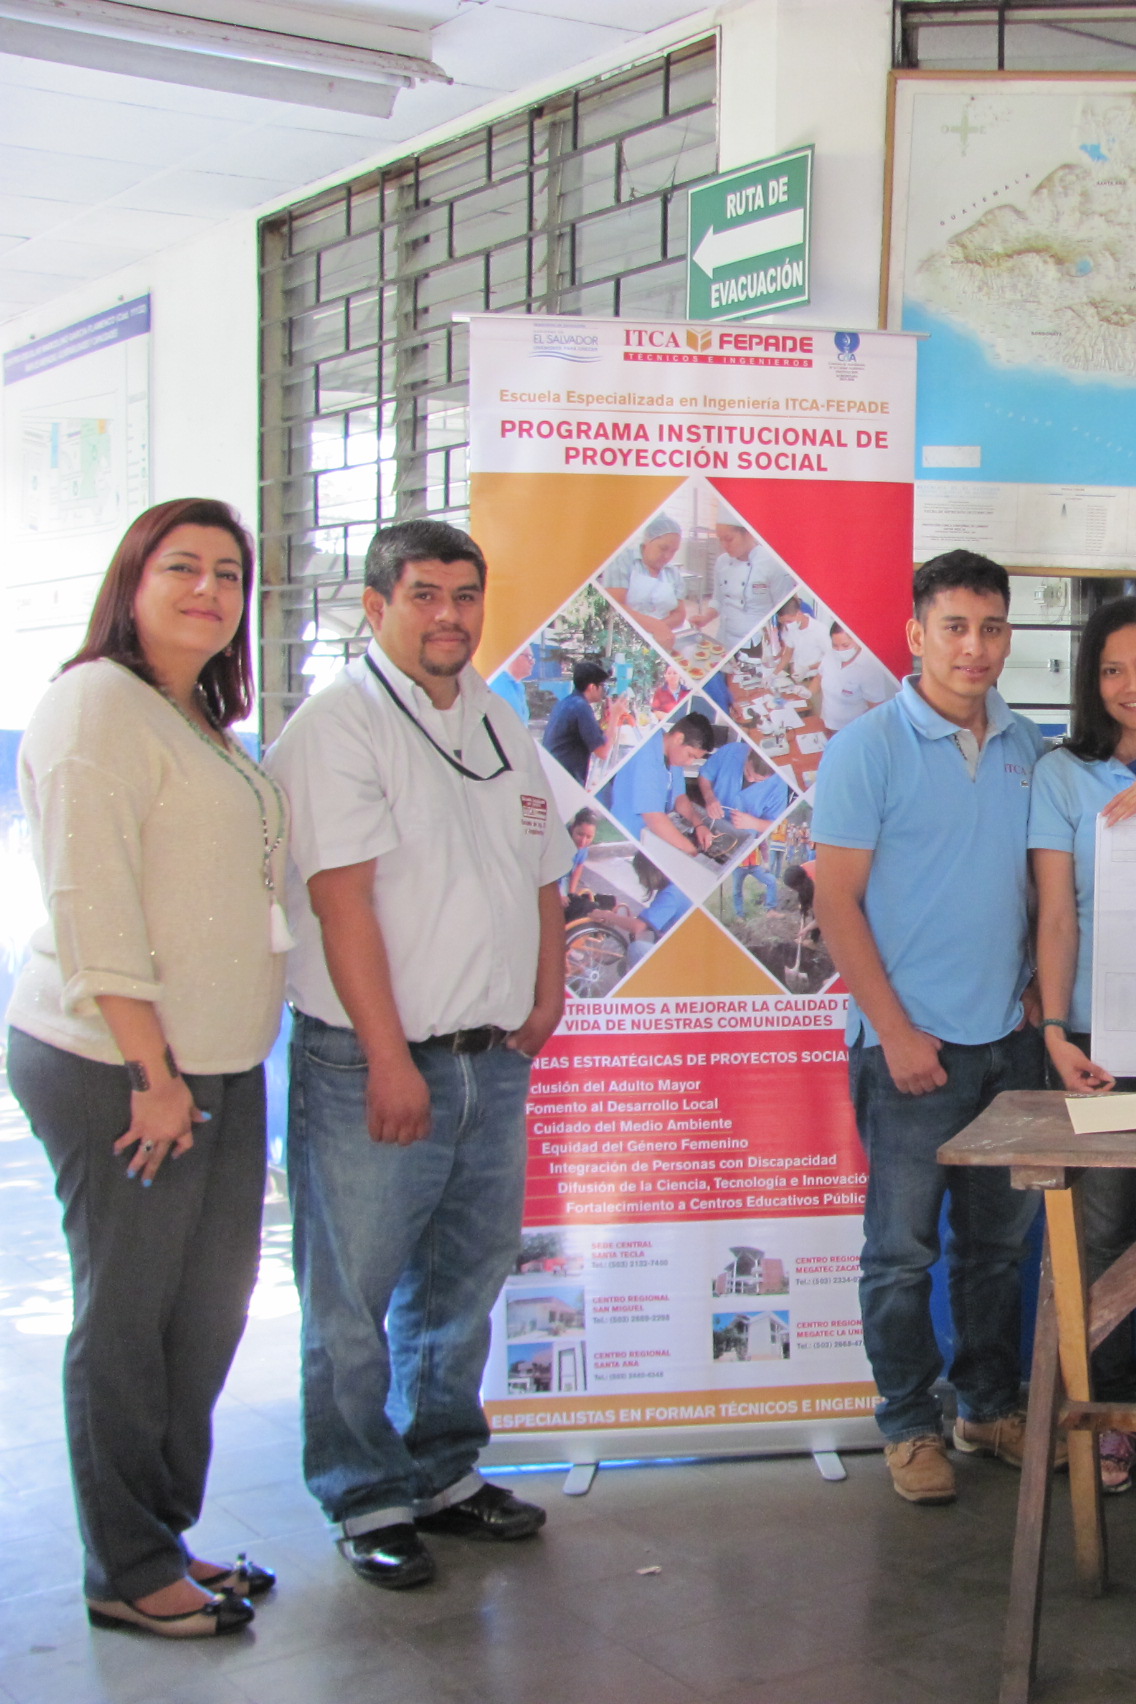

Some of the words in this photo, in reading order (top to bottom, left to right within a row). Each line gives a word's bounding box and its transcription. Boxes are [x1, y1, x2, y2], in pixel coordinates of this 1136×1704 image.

[726, 184, 764, 219] RUTA
[768, 176, 788, 206] DE
[711, 258, 803, 308] EVACUACIÓN
[533, 335, 544, 344] EL
[546, 335, 599, 346] SALVADOR
[624, 329, 681, 348] ITCA
[719, 333, 813, 353] FEPADE
[629, 353, 698, 363] TÉCNICOS
[724, 357, 809, 367] INGENIEROS
[500, 389, 561, 403] Escuela
[566, 390, 674, 407] Especializada
[680, 397, 698, 407] en
[703, 395, 780, 411] Ingeniería
[785, 398, 890, 414] ITCA-FEPADE
[501, 420, 650, 442] PROGRAMA
[659, 424, 848, 448] INSTITUCIONAL
[857, 430, 888, 449] DE
[565, 446, 728, 469] PROYECCIÓN
[737, 451, 828, 472] SOCIAL
[563, 1002, 655, 1016] TRIBUIMOS
[660, 1003, 671, 1014] A
[675, 1001, 747, 1014] MEJORAR
[752, 1000, 769, 1012] LA
[774, 999, 838, 1012] CALIDAD
[565, 1019, 601, 1032] VIDA
[606, 1019, 626, 1031] DE
[631, 1017, 713, 1030] NUESTRAS
[717, 1015, 833, 1029] COMUNIDADES
[531, 1056, 569, 1070] NEAS
[573, 1053, 683, 1068] ESTRATÉGICAS
[687, 1054, 707, 1066] DE
[710, 1051, 797, 1065] PROYECTOS
[530, 1082, 579, 1094] clusión
[583, 1080, 604, 1092] del
[608, 1080, 654, 1092] Adulto
[658, 1079, 701, 1093] Mayor
[525, 1102, 587, 1115] Fomento
[591, 1101, 603, 1113] al
[607, 1099, 679, 1112] Desarrollo
[683, 1098, 719, 1110] Local
[533, 1121, 591, 1134] Cuidado
[595, 1120, 615, 1132] del
[620, 1119, 663, 1132] Medio
[667, 1118, 733, 1131] Ambiente
[542, 1141, 598, 1156] Equidad
[602, 1141, 623, 1153] del
[627, 1140, 677, 1152] Género
[681, 1137, 748, 1150] Femenino
[550, 1161, 627, 1176] Integración
[631, 1161, 648, 1172] de
[652, 1158, 716, 1171] Personas
[719, 1158, 744, 1168] con
[748, 1154, 837, 1169] Discapacidad
[557, 1181, 616, 1194] Difusión
[620, 1181, 637, 1192] de
[640, 1180, 652, 1192] la
[657, 1178, 711, 1191] Ciencia,
[714, 1175, 787, 1190] Tecnología
[790, 1177, 798, 1186] e
[802, 1172, 870, 1186] Innovació
[566, 1200, 674, 1213] Fortalecimiento
[678, 1202, 686, 1210] a
[690, 1198, 742, 1210] Centros
[746, 1194, 819, 1208] Educativos
[823, 1192, 866, 1205] Públic
[616, 1241, 653, 1249] CENTRAL
[796, 1256, 828, 1264] CENTRO
[830, 1255, 862, 1263] REGION
[796, 1265, 834, 1273] MEGATEC
[835, 1264, 861, 1272] ZACAT
[593, 1295, 626, 1304] CENTRO
[627, 1294, 670, 1302] REGIONAL
[612, 1304, 643, 1312] MIGUEL
[797, 1321, 829, 1329] CENTRO
[831, 1319, 863, 1327] REGION
[797, 1330, 835, 1338] MEGATEC
[837, 1329, 846, 1337] LA
[848, 1328, 864, 1336] UNI
[594, 1351, 627, 1359] CENTRO
[629, 1349, 671, 1357] REGIONAL
[594, 1361, 620, 1369] SANTA
[492, 1410, 616, 1429] ESPECIALISTAS
[620, 1408, 641, 1422] EN
[646, 1405, 716, 1421] FORMAR
[720, 1401, 798, 1417] TÉCNICOS
[802, 1399, 812, 1413] E
[815, 1396, 886, 1411] INGENIE
